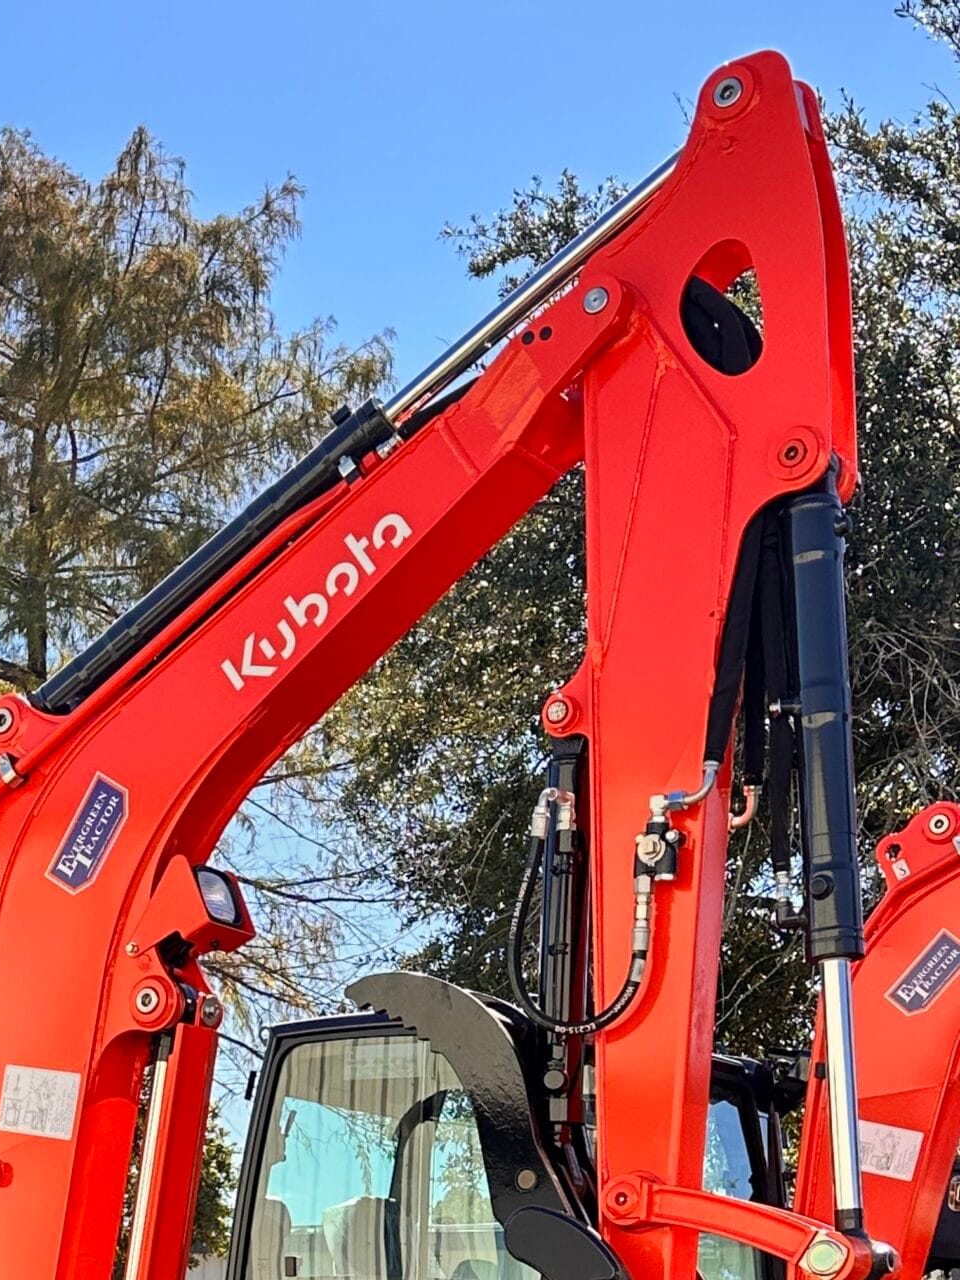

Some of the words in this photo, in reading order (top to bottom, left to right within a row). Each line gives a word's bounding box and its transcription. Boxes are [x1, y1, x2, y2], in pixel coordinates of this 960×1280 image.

[220, 513, 413, 692] Kubota
[55, 791, 108, 879] EVERGREEN
[76, 795, 120, 870] TRACTOR
[896, 944, 950, 1003] EVERGREEN
[914, 948, 960, 1000] TRACTOR
